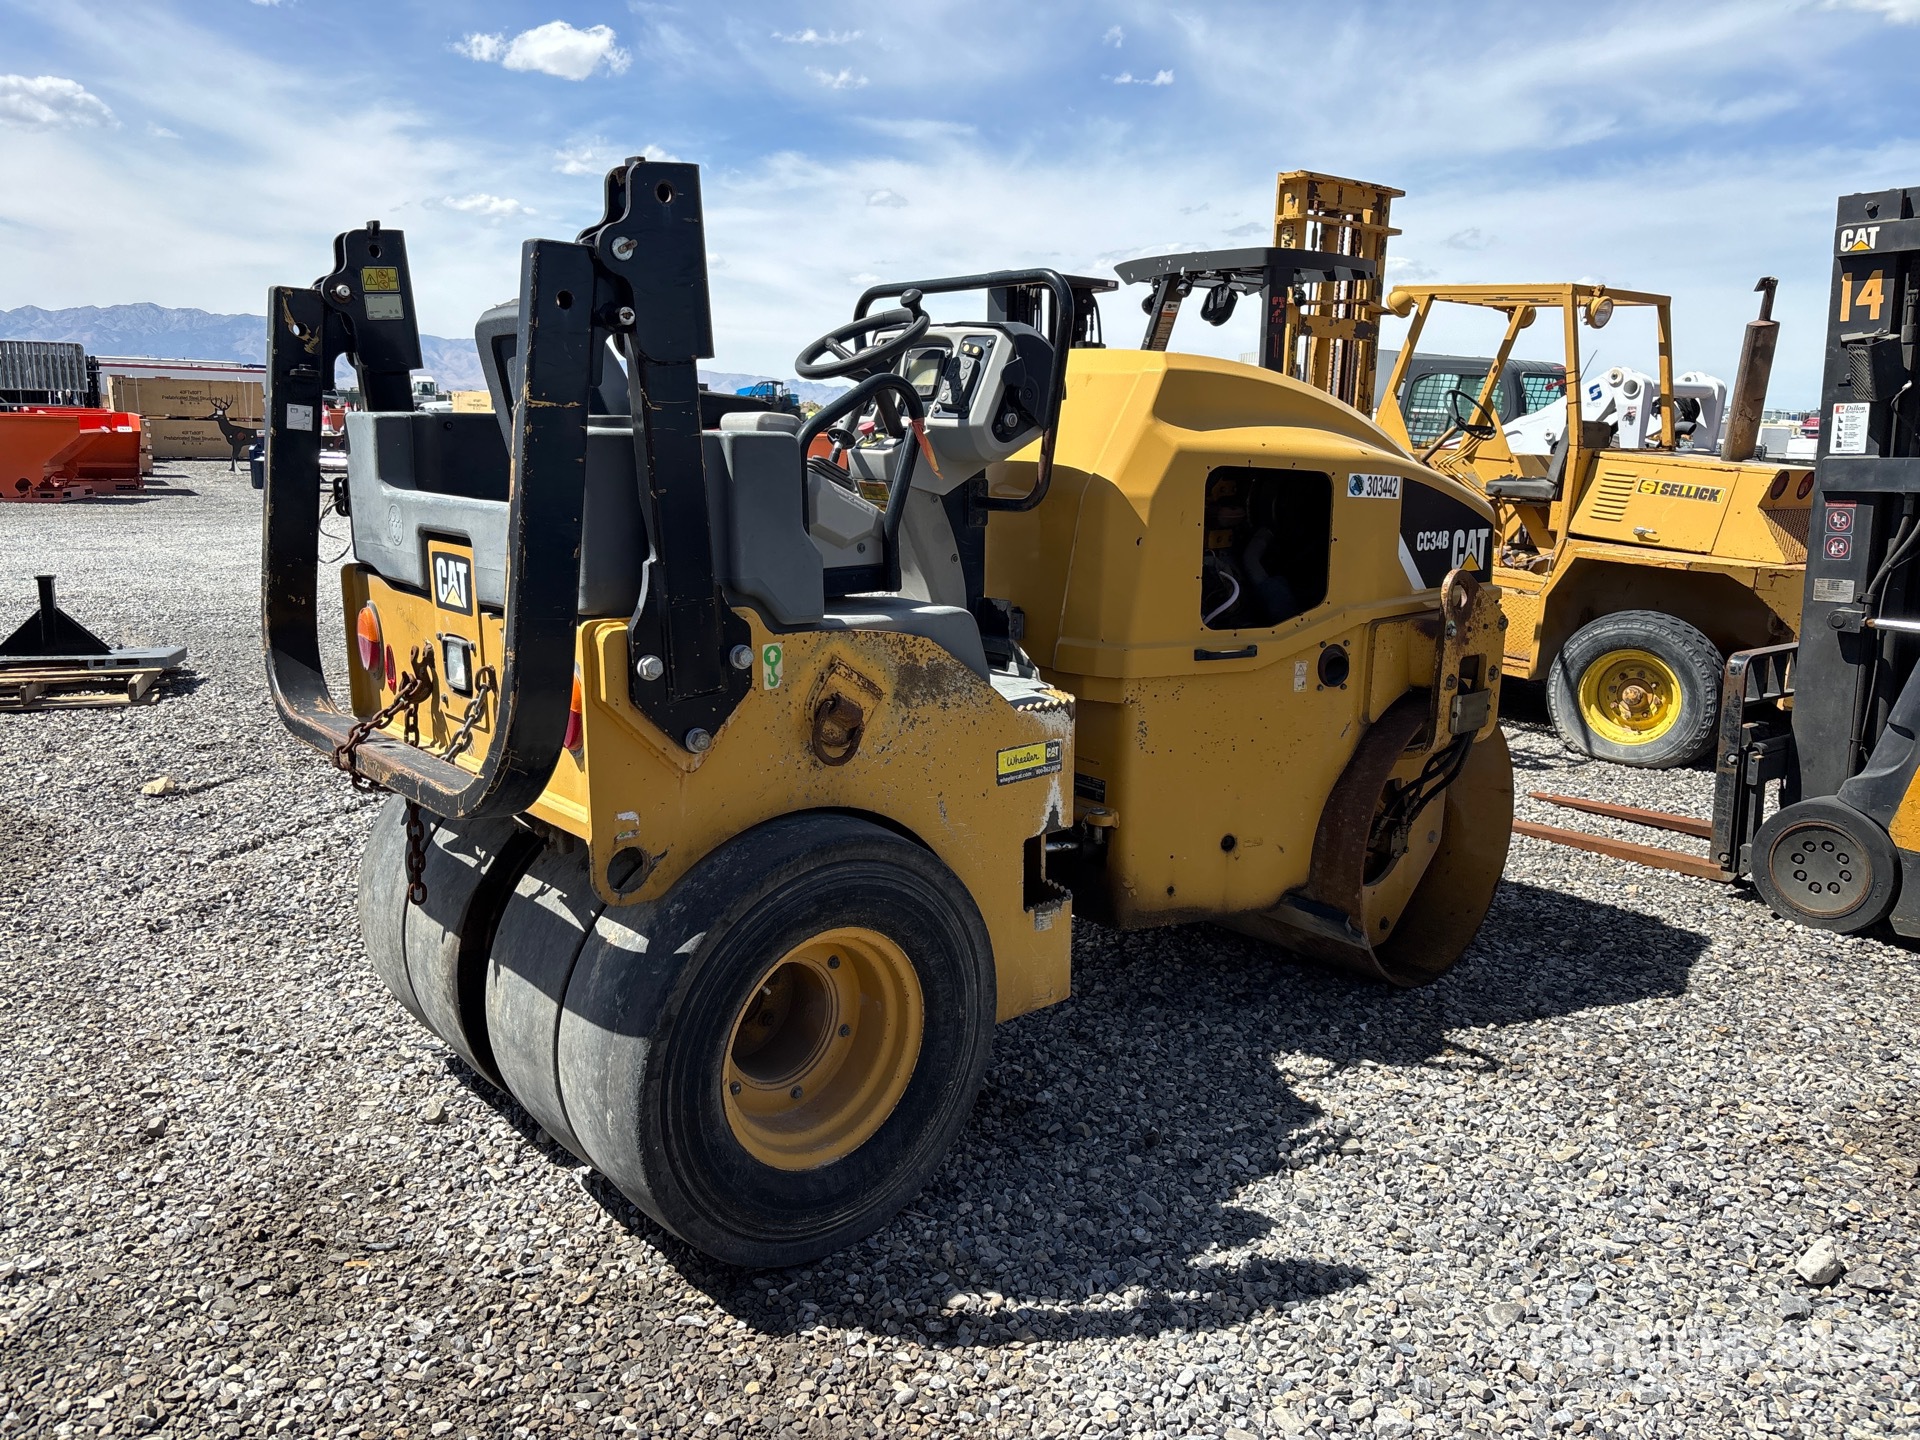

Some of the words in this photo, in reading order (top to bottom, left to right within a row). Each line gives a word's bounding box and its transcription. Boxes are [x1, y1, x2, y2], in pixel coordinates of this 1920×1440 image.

[1840, 226, 1880, 252] CAT
[1840, 269, 1885, 322] 14
[1366, 476, 1398, 497] 303442
[1661, 483, 1721, 502] SELLICK
[1416, 530, 1450, 552] CC34B
[1451, 528, 1490, 571] CAT
[436, 557, 468, 609] CAT
[1006, 752, 1040, 766] Wheeler
[1046, 746, 1059, 757] CAT
